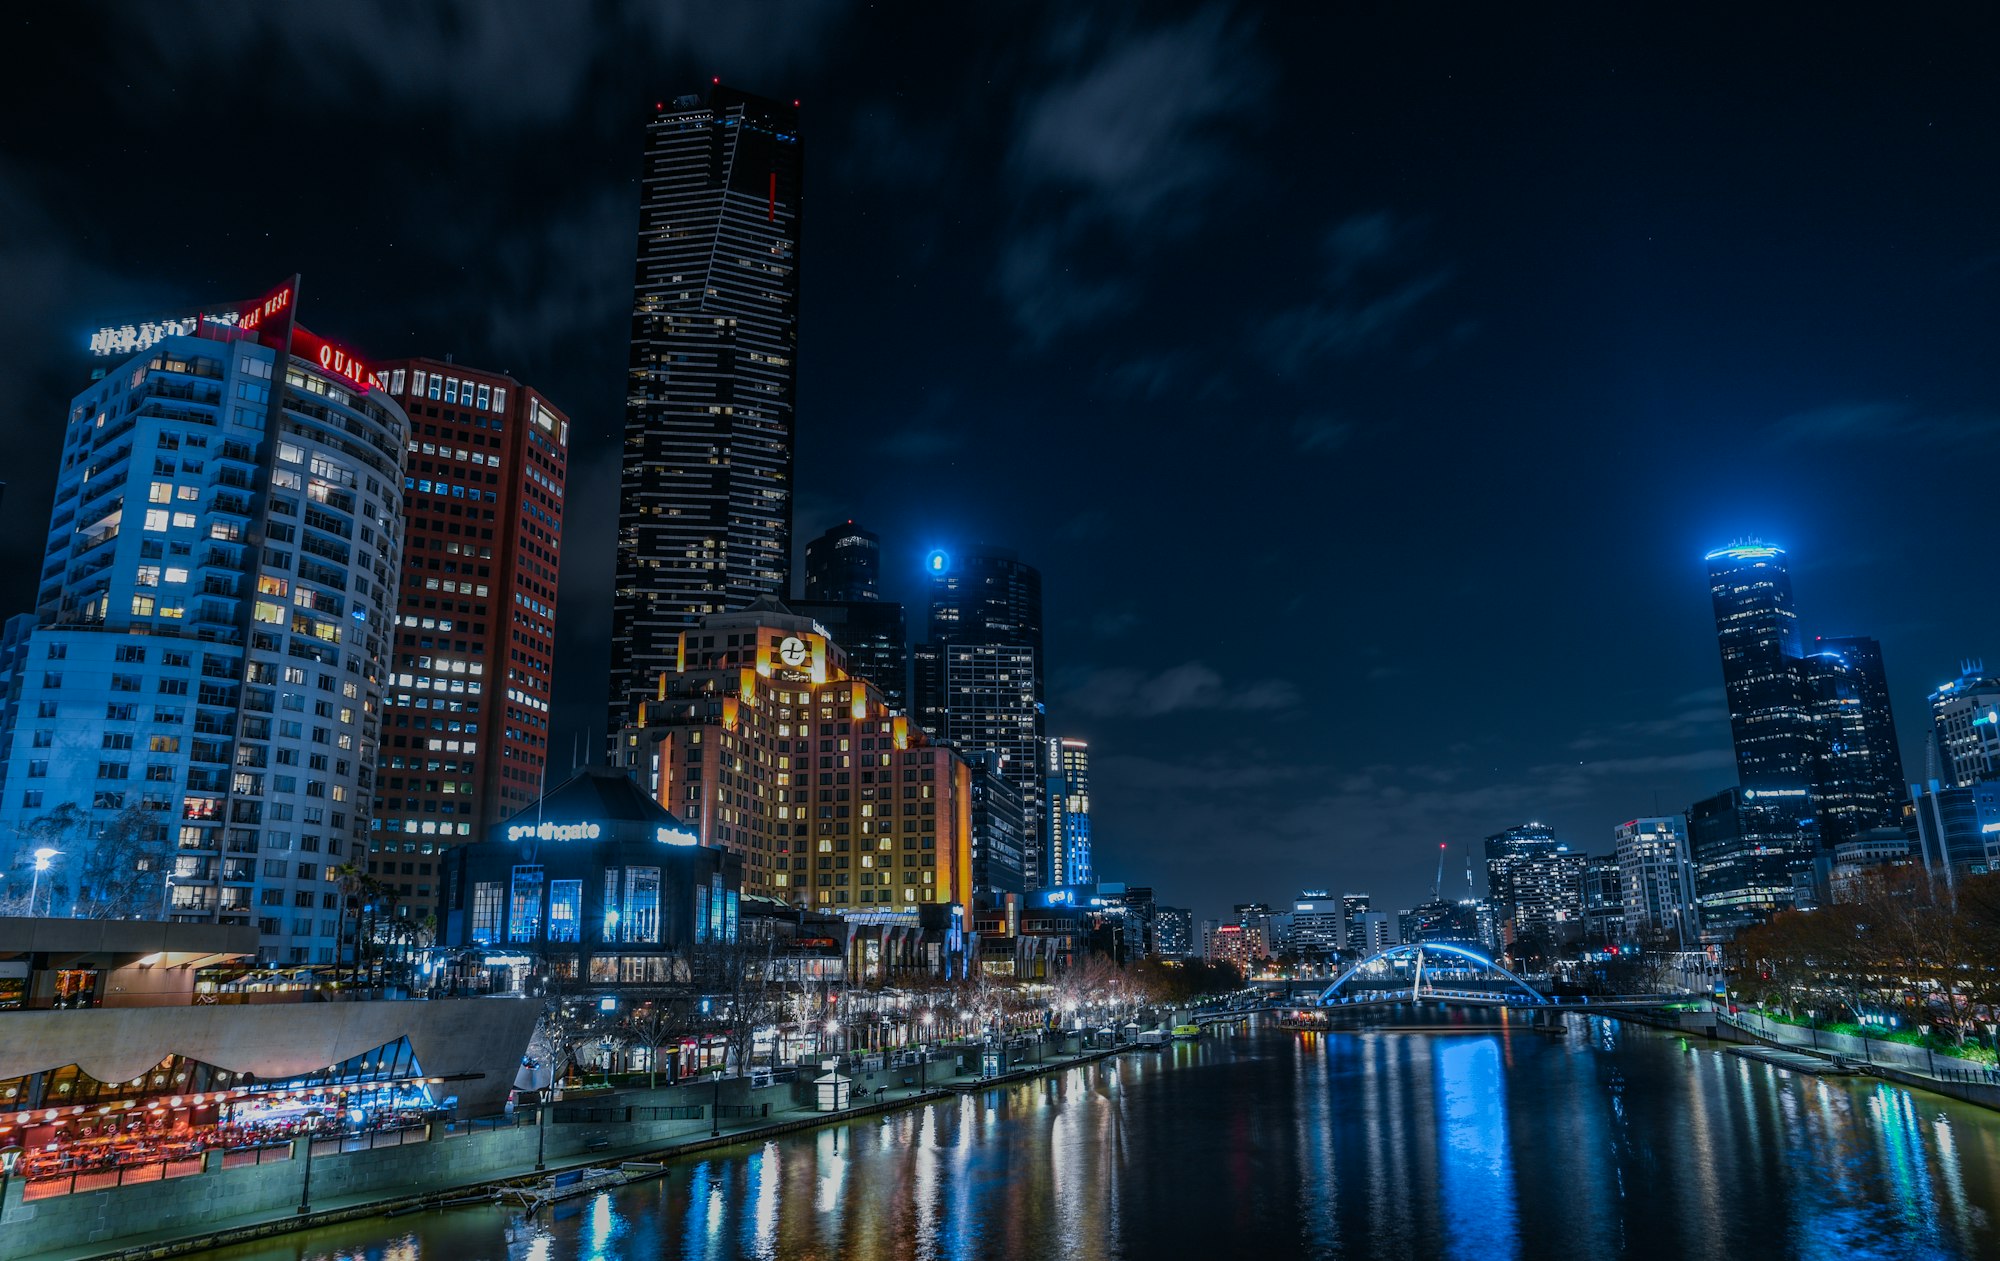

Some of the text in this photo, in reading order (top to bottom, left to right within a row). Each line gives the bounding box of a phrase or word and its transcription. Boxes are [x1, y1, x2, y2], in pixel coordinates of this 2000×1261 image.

[265, 289, 289, 317] WEST
[320, 345, 363, 384] QUAY
[1050, 738, 1059, 771] CROWN
